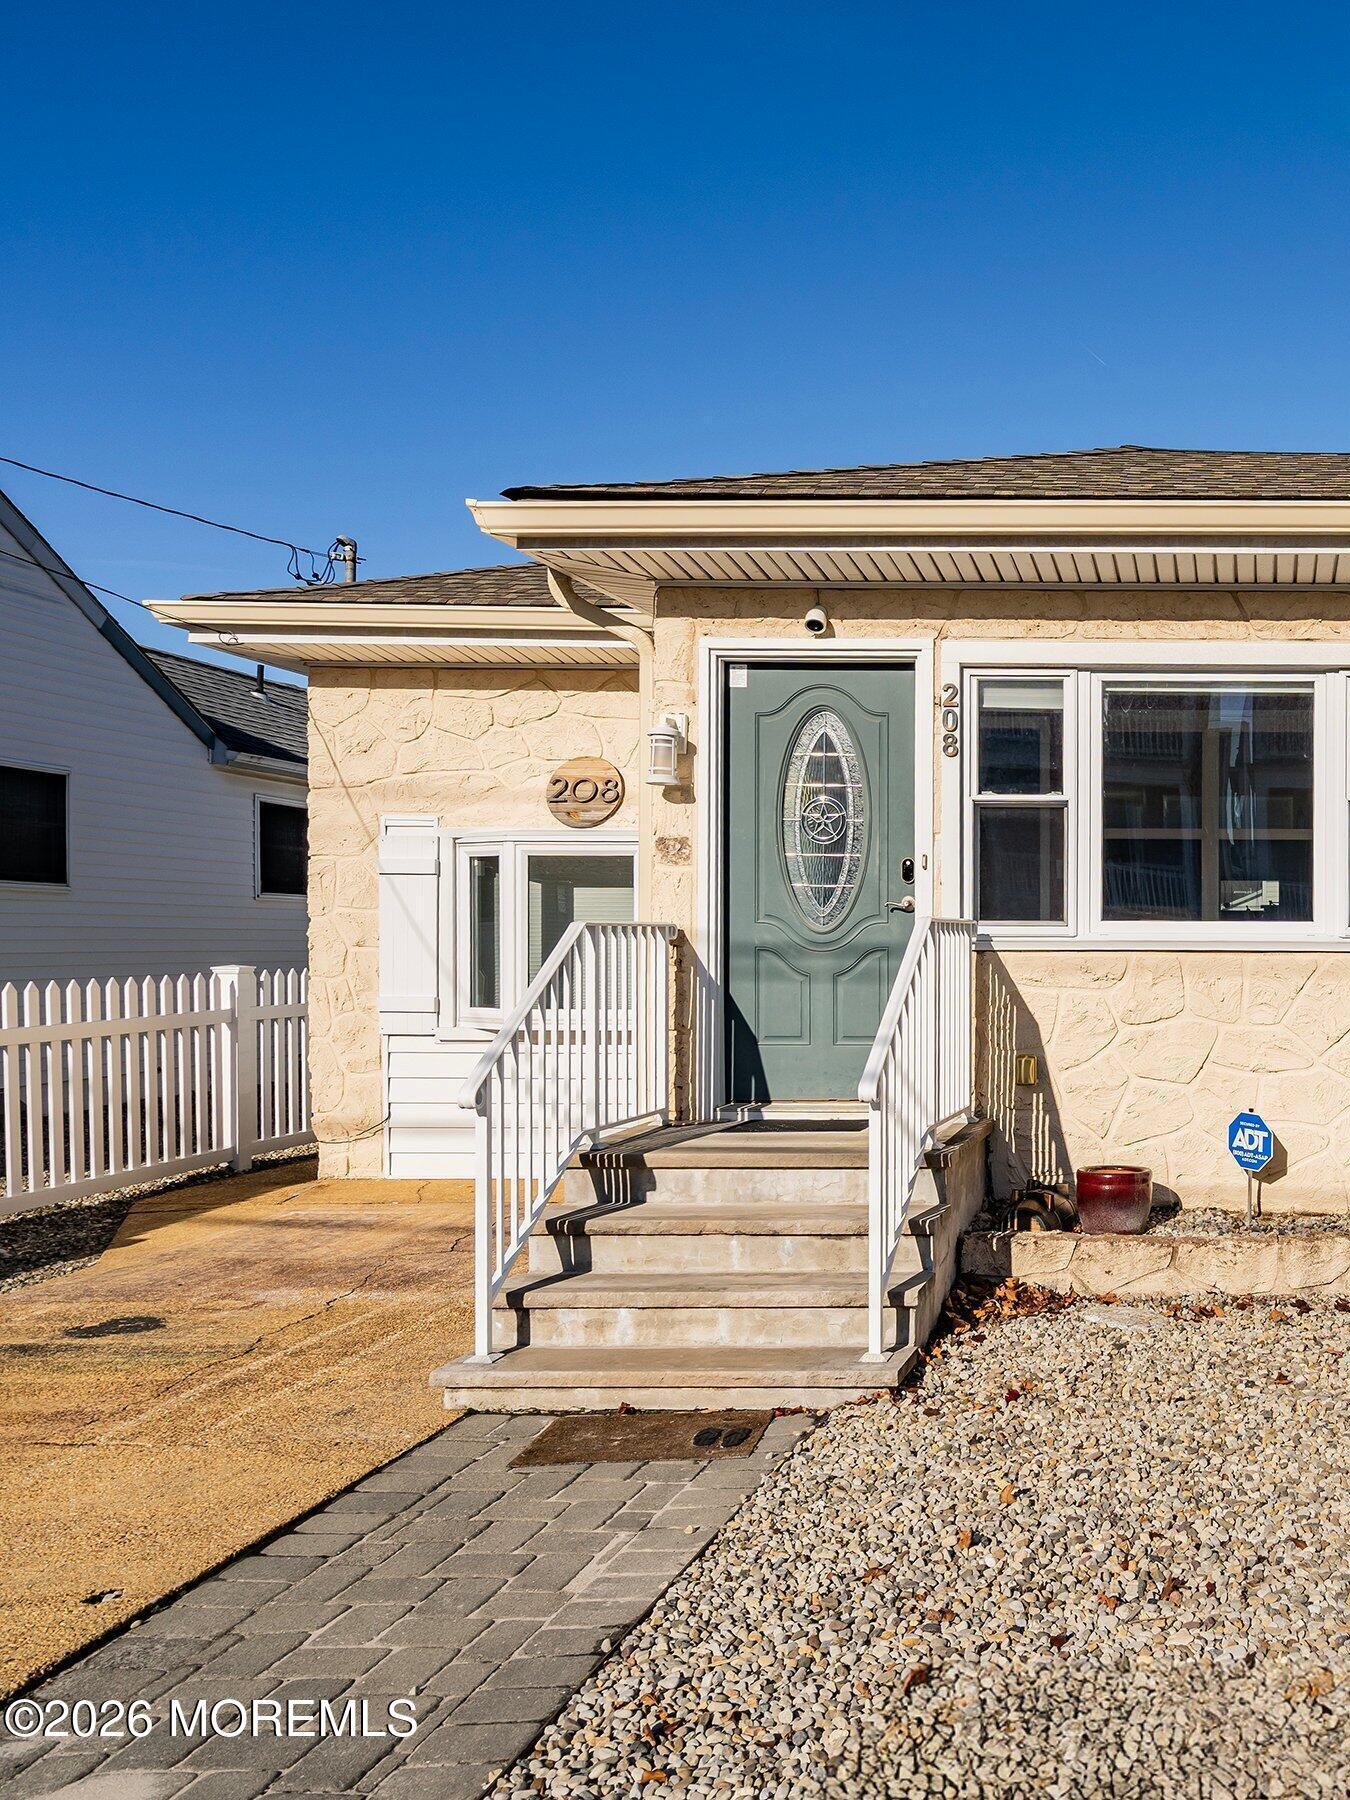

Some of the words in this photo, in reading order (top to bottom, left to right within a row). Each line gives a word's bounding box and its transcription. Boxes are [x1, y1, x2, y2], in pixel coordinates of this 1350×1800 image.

[942, 683, 959, 758] 208
[548, 778, 620, 804] 208
[1232, 1128, 1269, 1152] ADT
